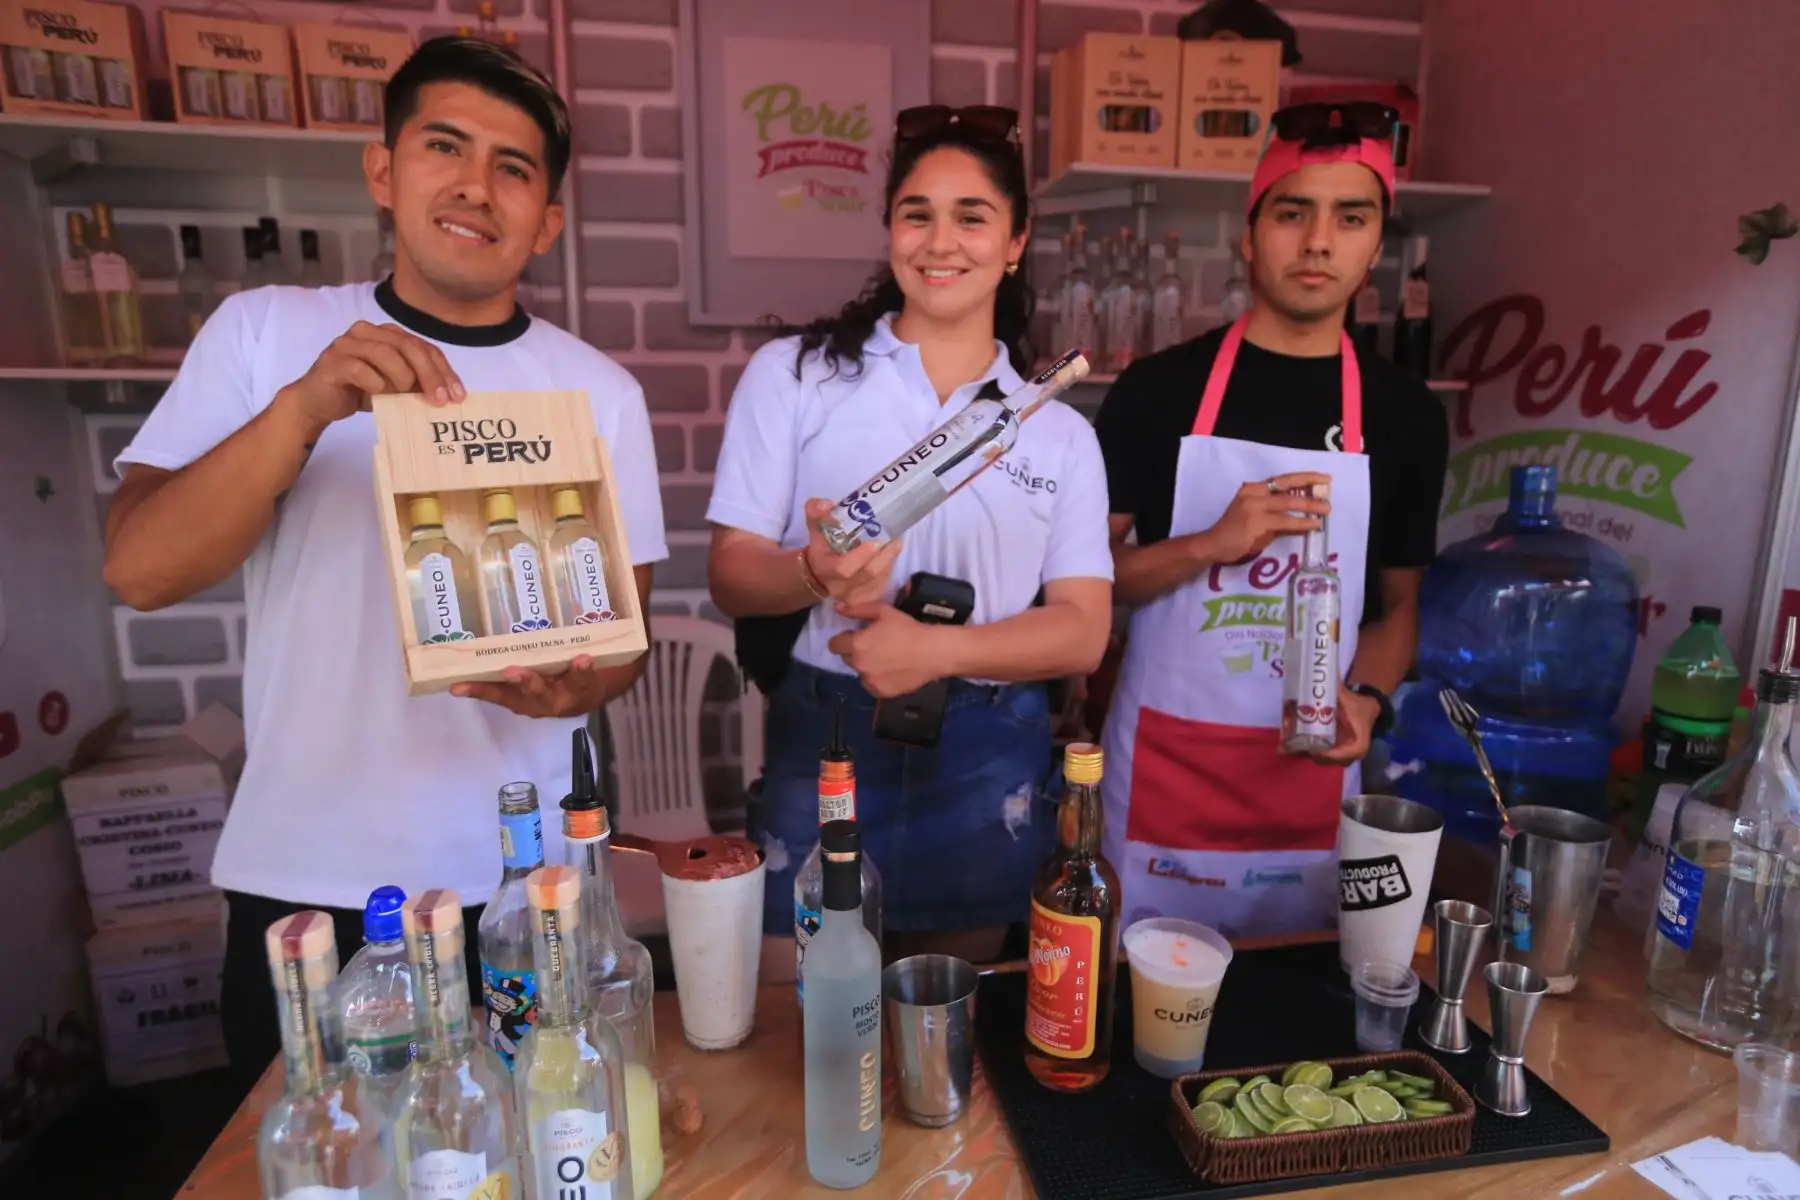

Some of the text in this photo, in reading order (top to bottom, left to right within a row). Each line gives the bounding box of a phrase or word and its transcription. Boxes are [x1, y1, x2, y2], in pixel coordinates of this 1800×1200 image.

[742, 82, 873, 142] Perú
[1437, 294, 1720, 438] Perú
[431, 418, 517, 443] PISCO
[438, 434, 552, 465] ES PERÚ
[867, 432, 948, 495] CUNEO
[991, 460, 1058, 495] CUNEO
[1600, 510, 1635, 542] del
[432, 570, 453, 629] CUNEO
[522, 559, 541, 616] CUNEO
[583, 553, 603, 609] CUNEO
[475, 645, 510, 657] BODEGA
[511, 641, 539, 653] CUNEO
[540, 637, 565, 649] TACNA
[1312, 620, 1329, 700] CUNEO
[1342, 873, 1407, 904] BAR
[547, 915, 561, 972] QUEBRANTA
[852, 994, 880, 1019] PISCO
[1154, 1007, 1213, 1024] CUNE
[858, 1051, 877, 1132] CUNEO
